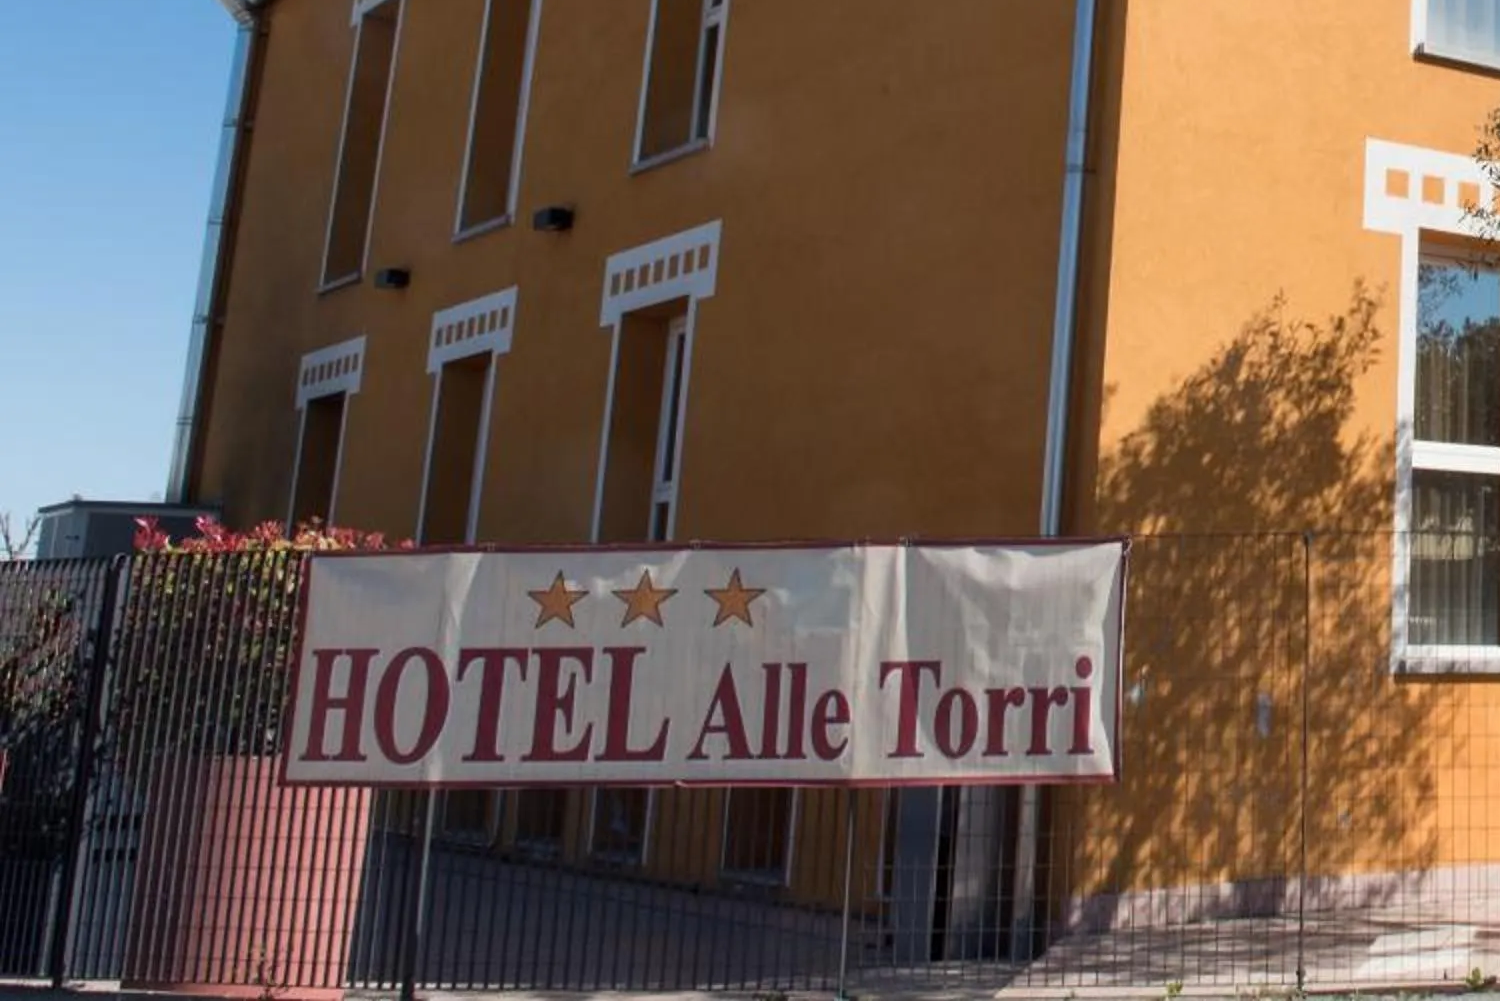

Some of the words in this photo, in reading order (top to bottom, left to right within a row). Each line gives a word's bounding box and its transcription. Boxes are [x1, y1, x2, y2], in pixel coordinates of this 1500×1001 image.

[298, 645, 671, 765] HOTEL
[686, 661, 851, 762] Alle
[879, 656, 1096, 761] Torri
